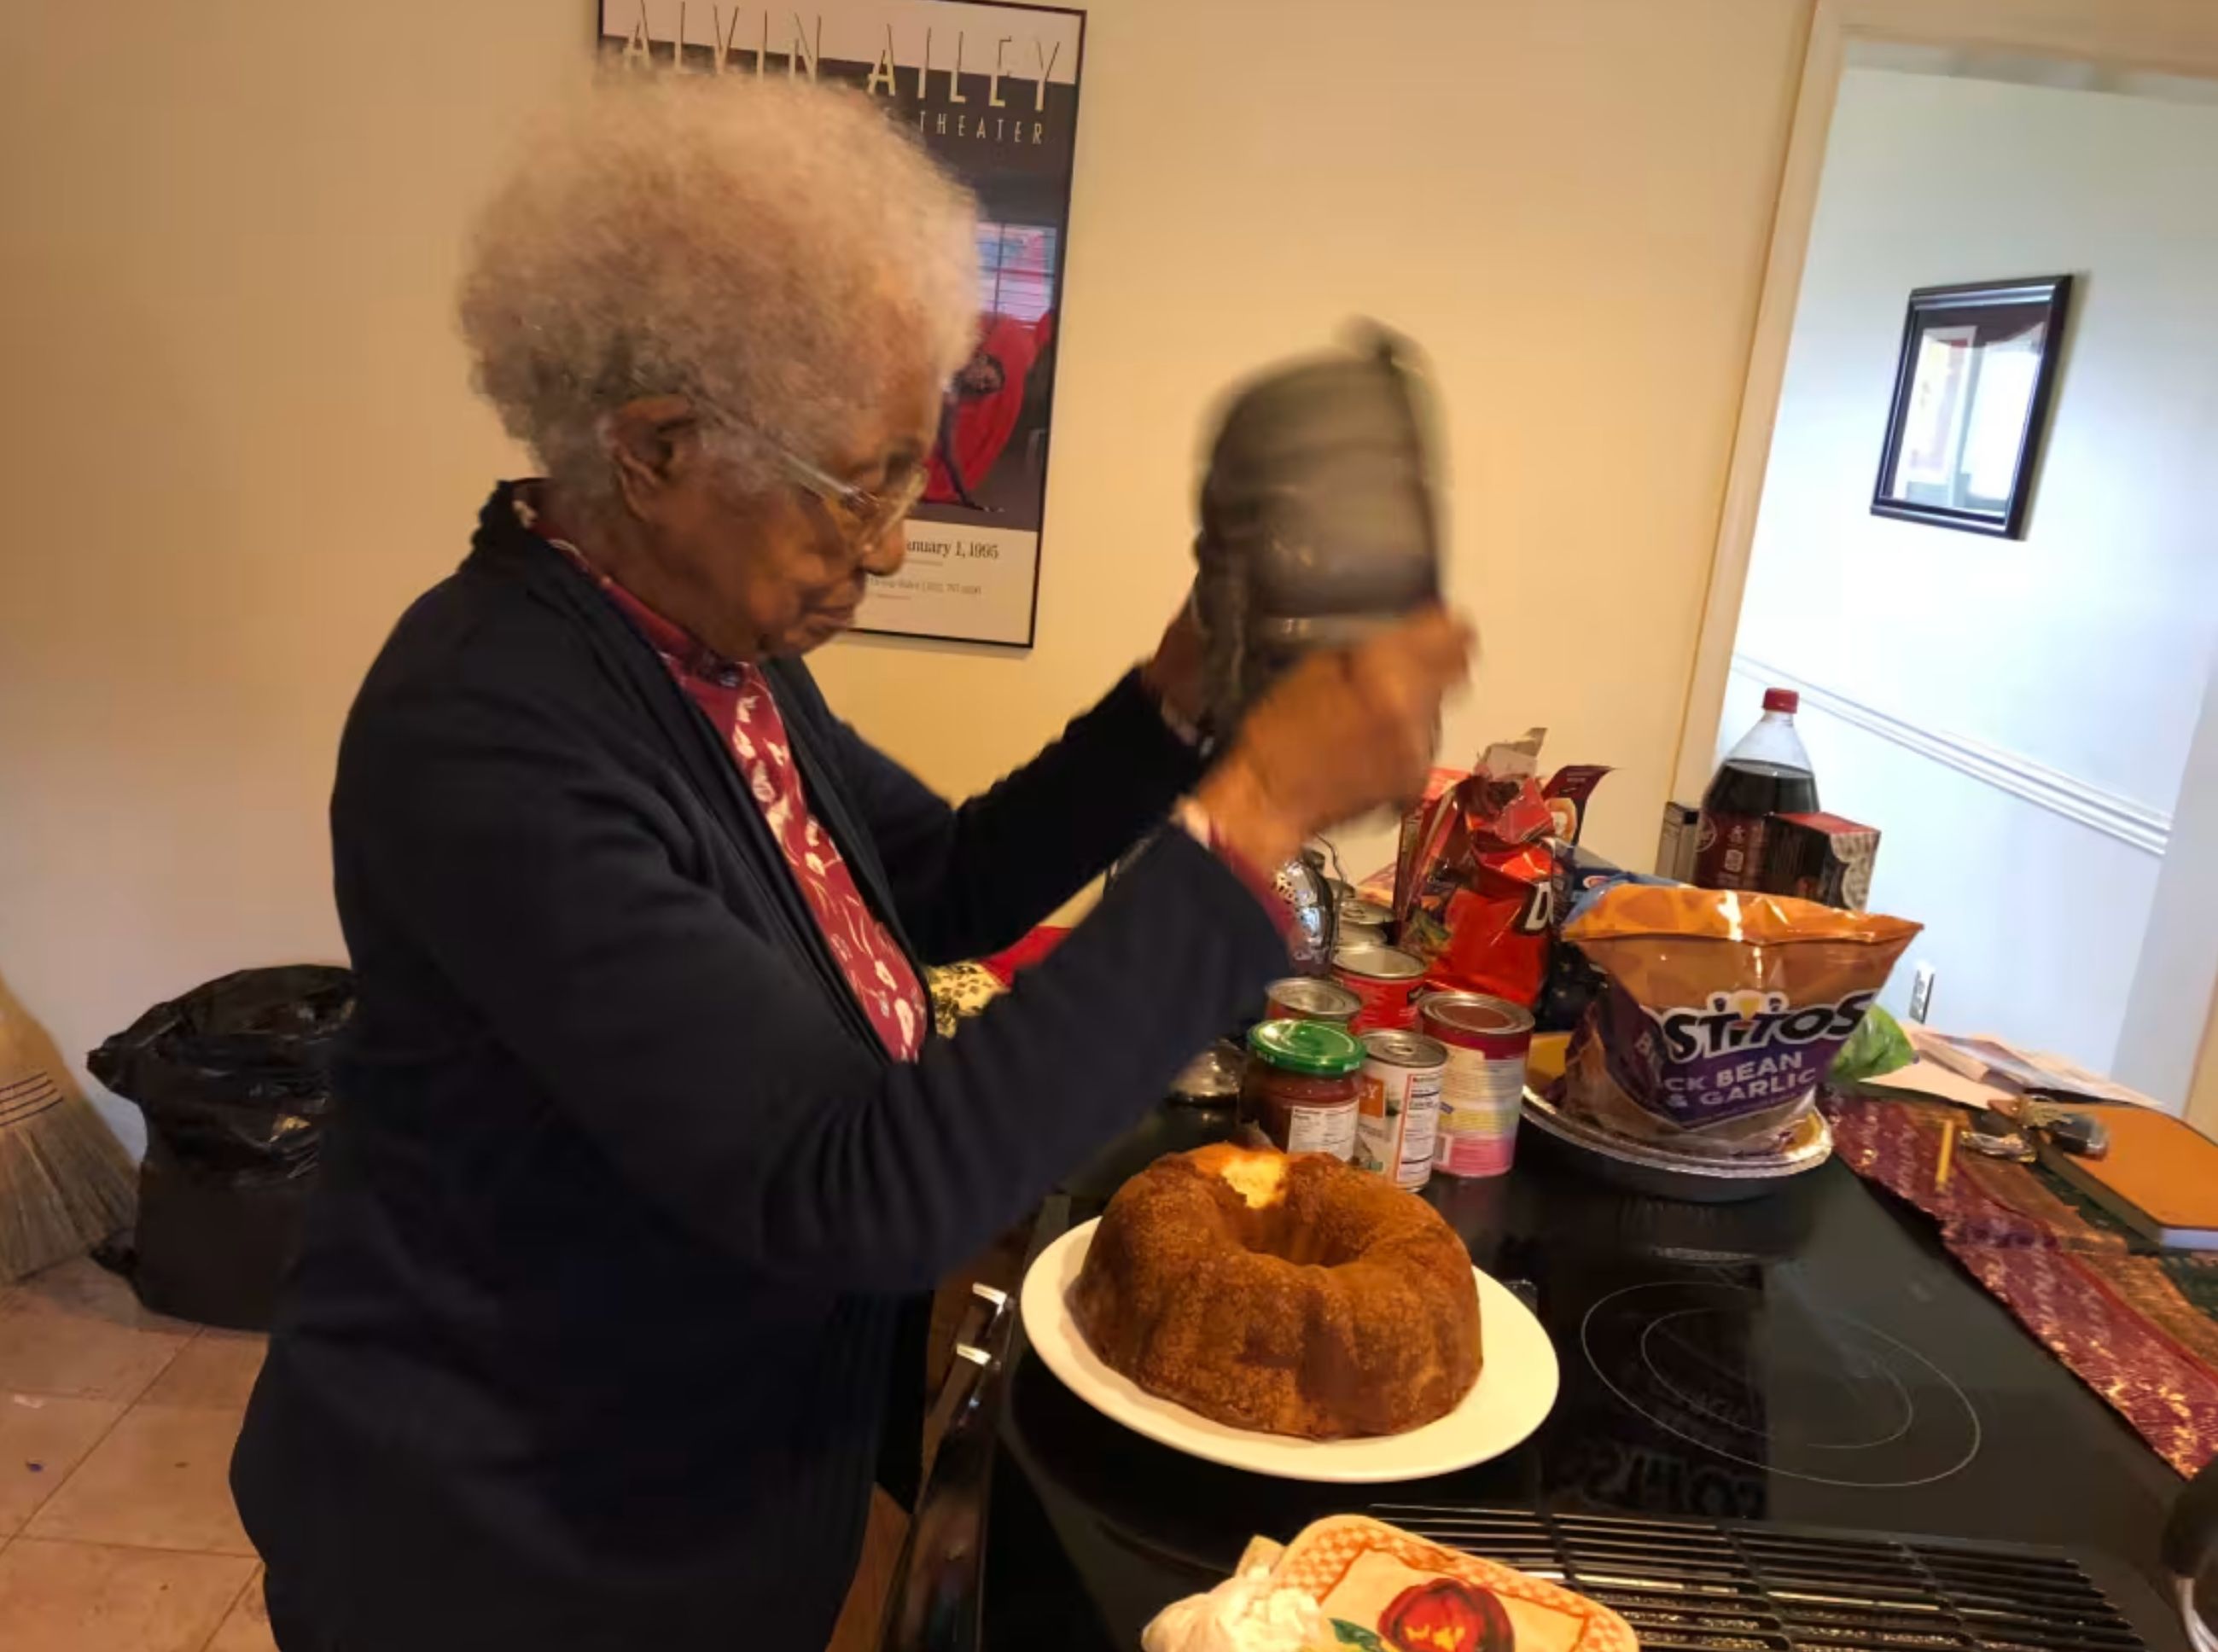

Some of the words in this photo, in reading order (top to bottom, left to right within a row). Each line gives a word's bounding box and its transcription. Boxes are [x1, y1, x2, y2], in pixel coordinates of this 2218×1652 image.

[622, 0, 822, 83] ALVIN
[867, 23, 1061, 112] AILEY
[919, 109, 1043, 145] THEATER
[906, 541, 951, 558] anuary
[1699, 1067, 1816, 1106] GARLIC
[1716, 1051, 1802, 1089] BEAN
